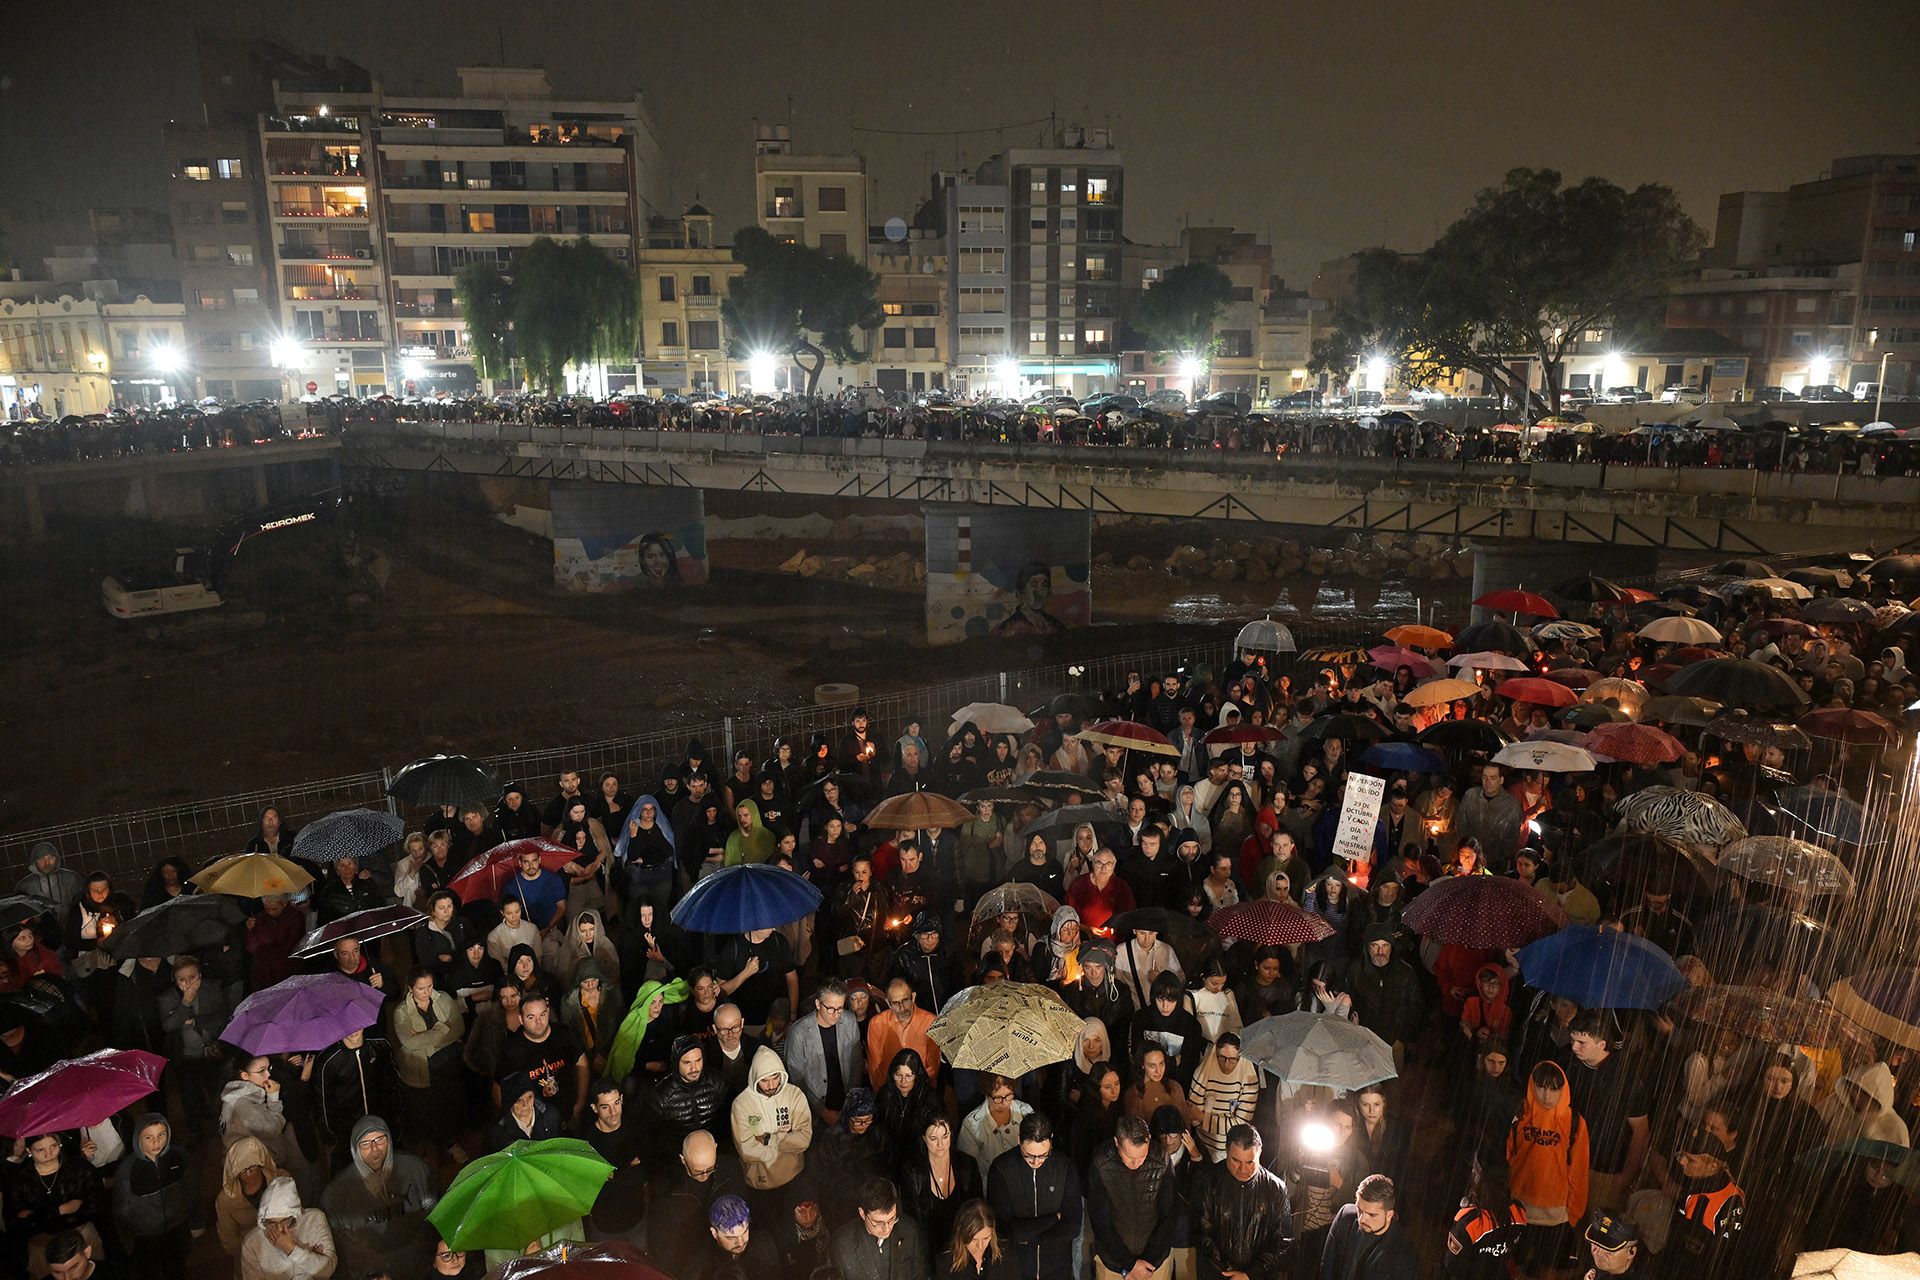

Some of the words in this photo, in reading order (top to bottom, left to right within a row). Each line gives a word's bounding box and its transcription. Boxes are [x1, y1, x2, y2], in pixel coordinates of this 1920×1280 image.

[260, 512, 316, 531] HIDROMEK
[1346, 807, 1373, 818] OCTUBRE
[1352, 817, 1370, 826] CADA
[1339, 839, 1367, 851] NUESTRAS
[1343, 848, 1360, 857] VIDAS
